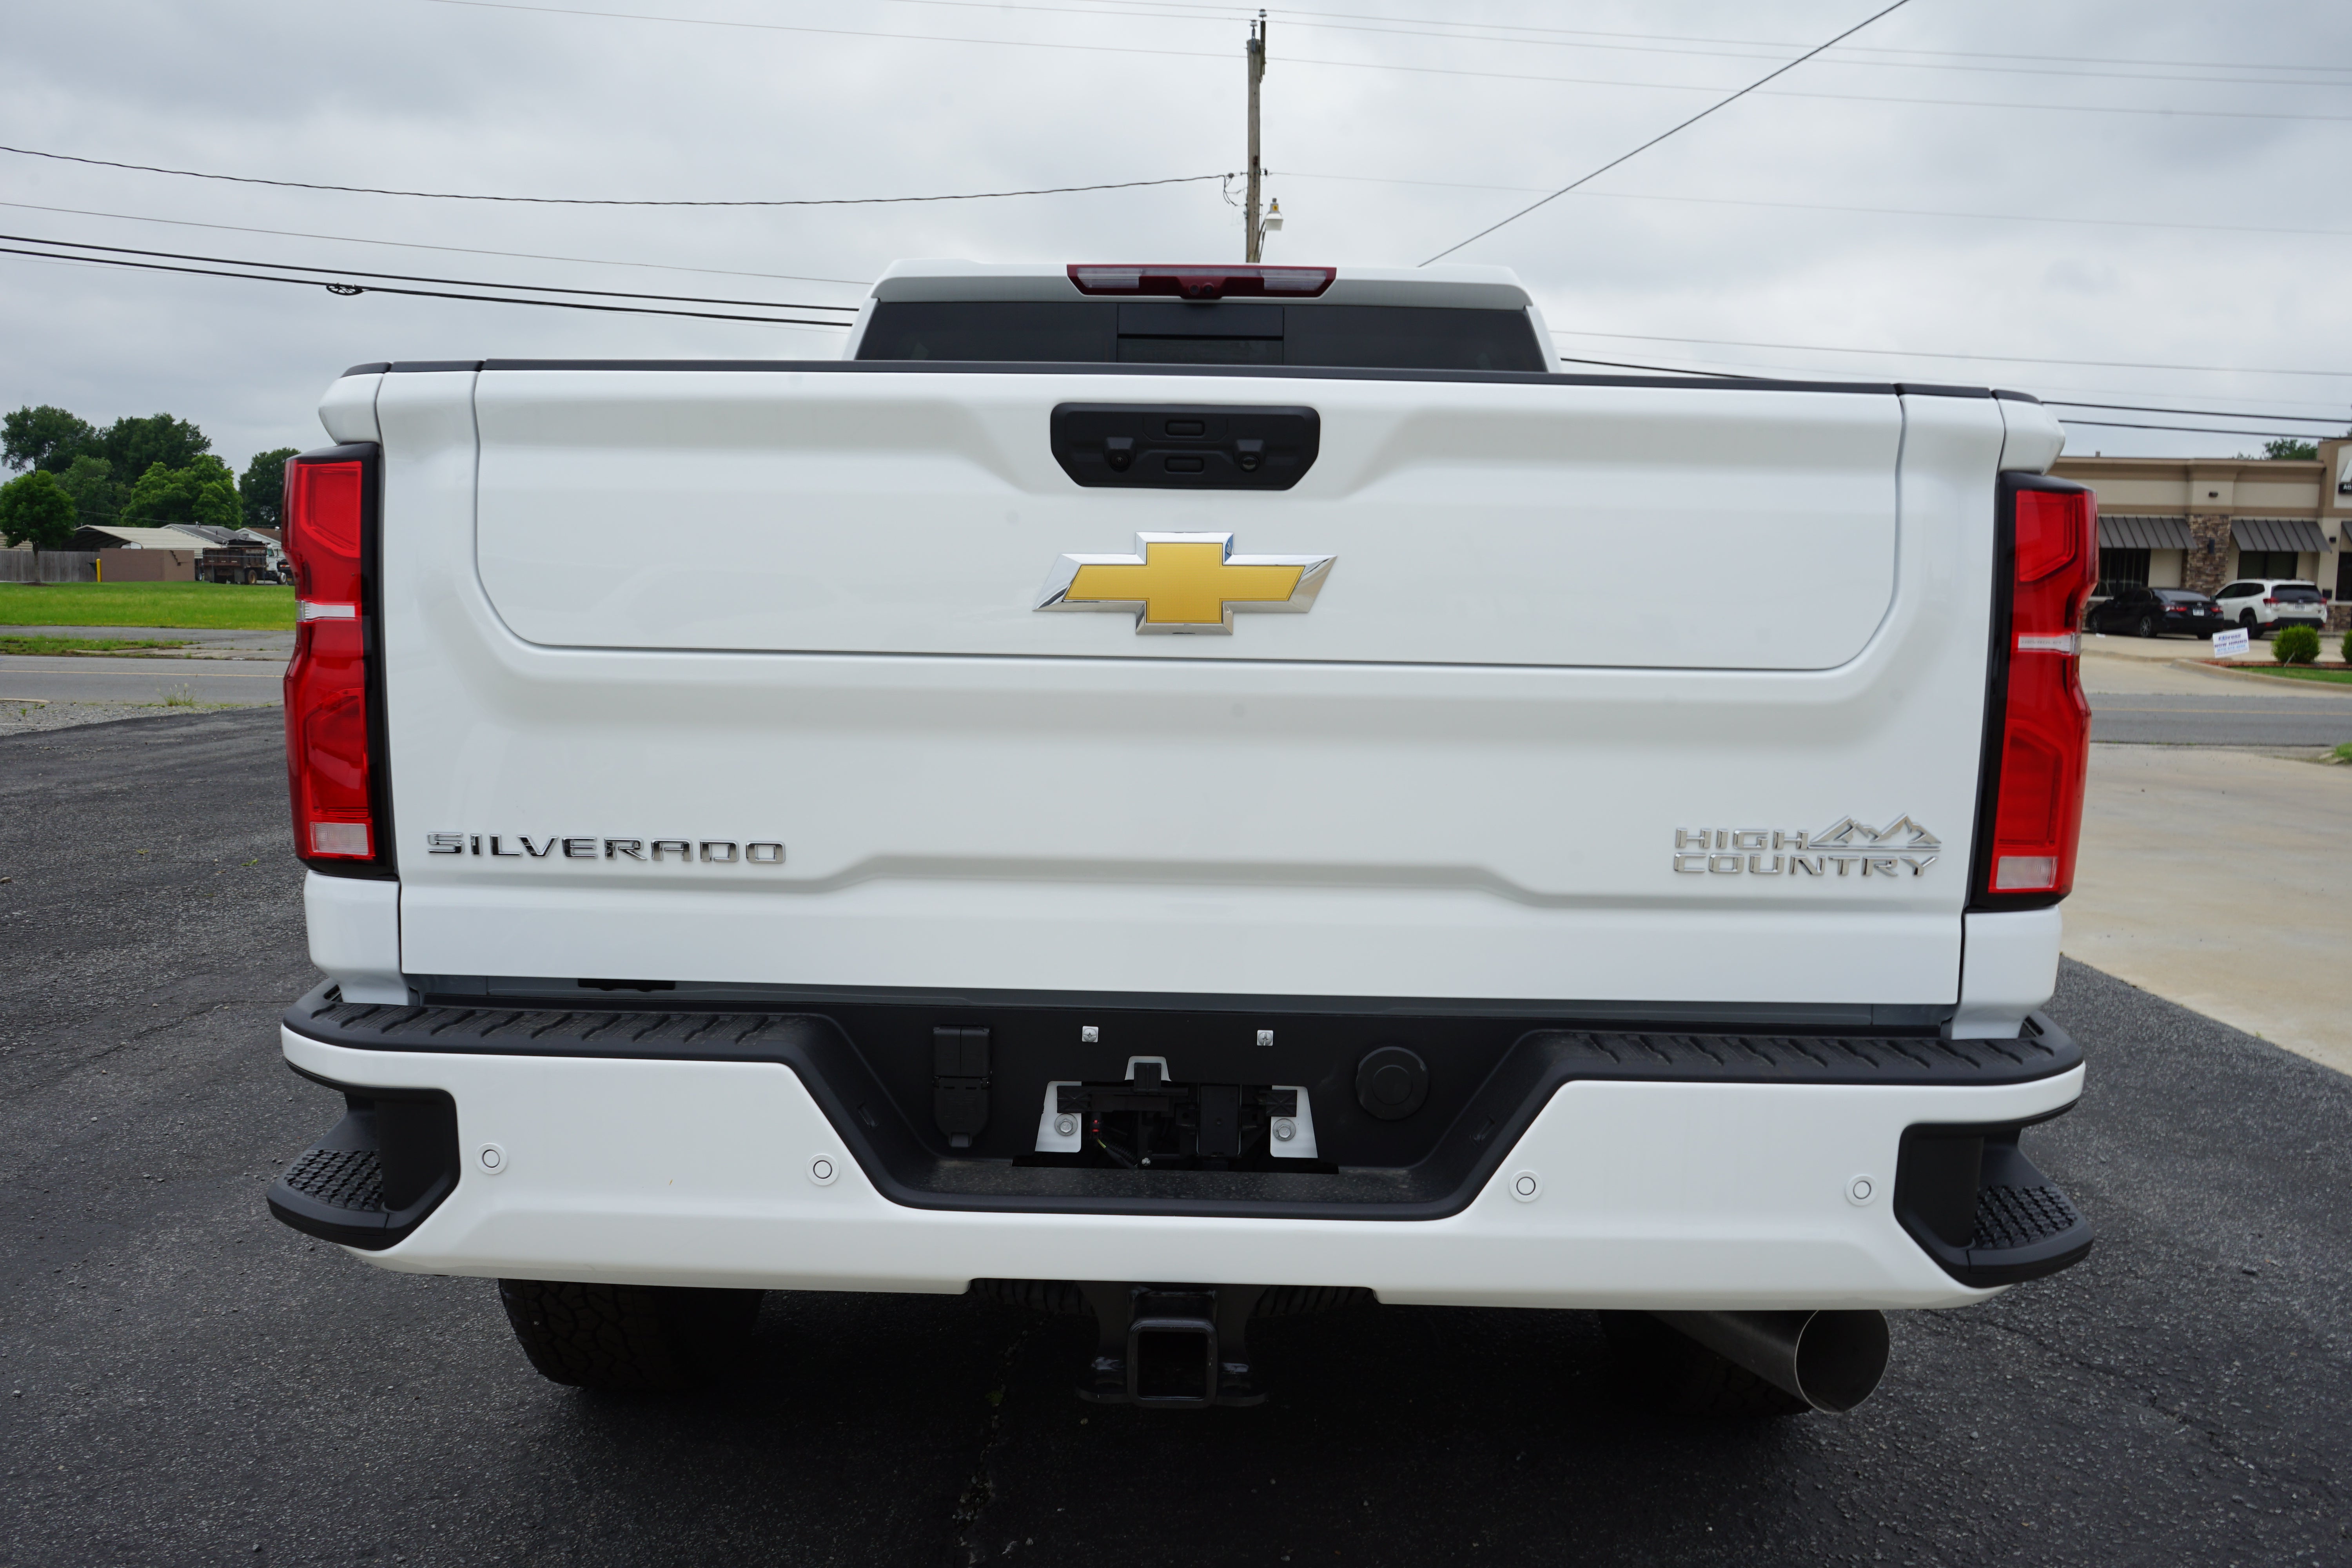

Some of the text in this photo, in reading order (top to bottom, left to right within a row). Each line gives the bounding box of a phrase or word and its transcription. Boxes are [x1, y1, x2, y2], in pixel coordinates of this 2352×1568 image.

[427, 831, 786, 864] SILVERADO
[1675, 828, 1809, 850] HIGH
[1673, 853, 1938, 877] COUNTRY
